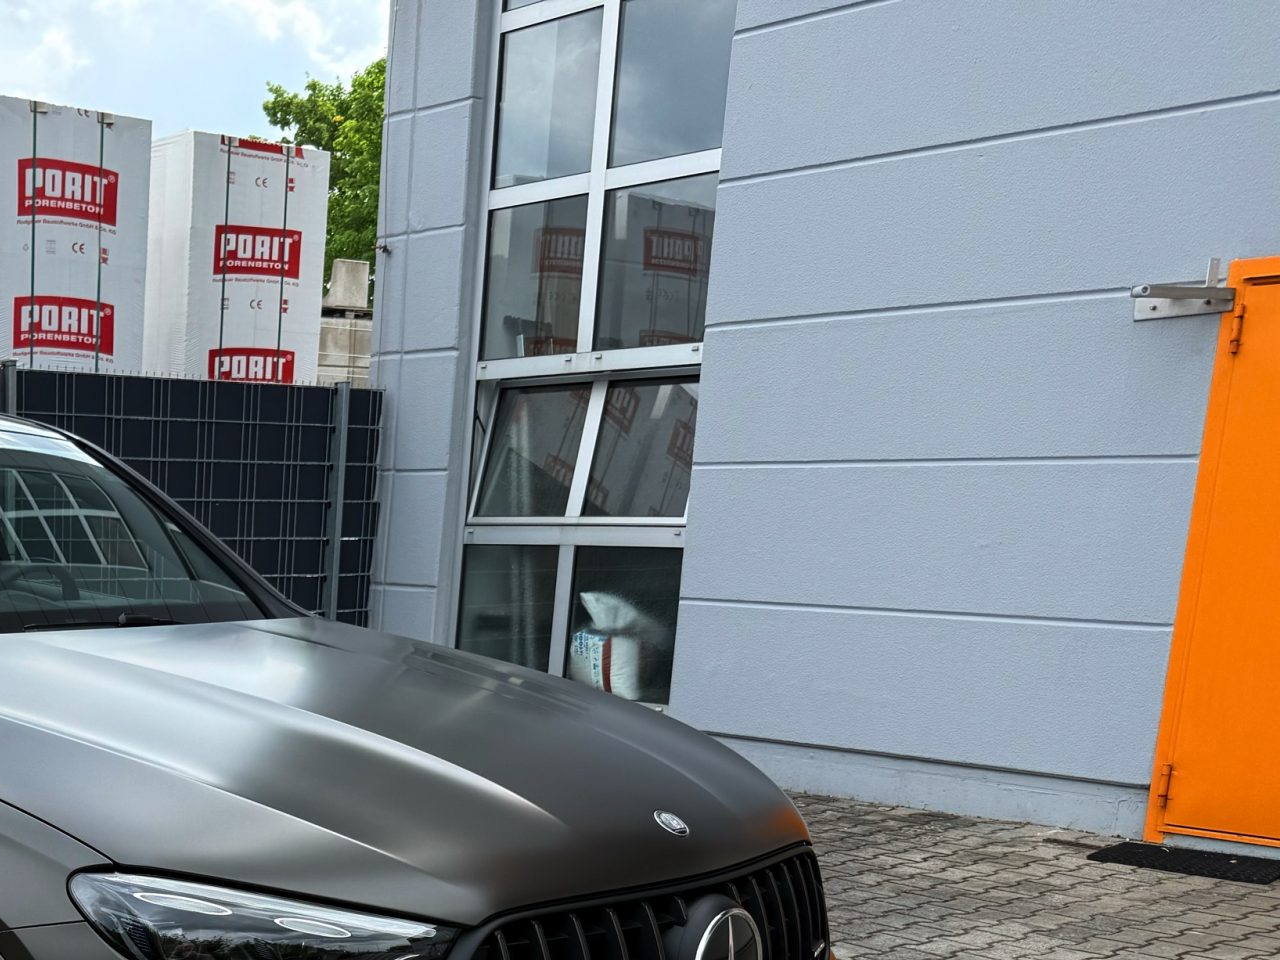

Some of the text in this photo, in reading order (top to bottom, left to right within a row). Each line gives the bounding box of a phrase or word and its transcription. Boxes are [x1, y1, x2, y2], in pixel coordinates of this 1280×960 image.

[255, 176, 269, 188] CE
[25, 199, 104, 215] PORENBETON
[72, 242, 86, 254] CE
[249, 299, 263, 310] CE
